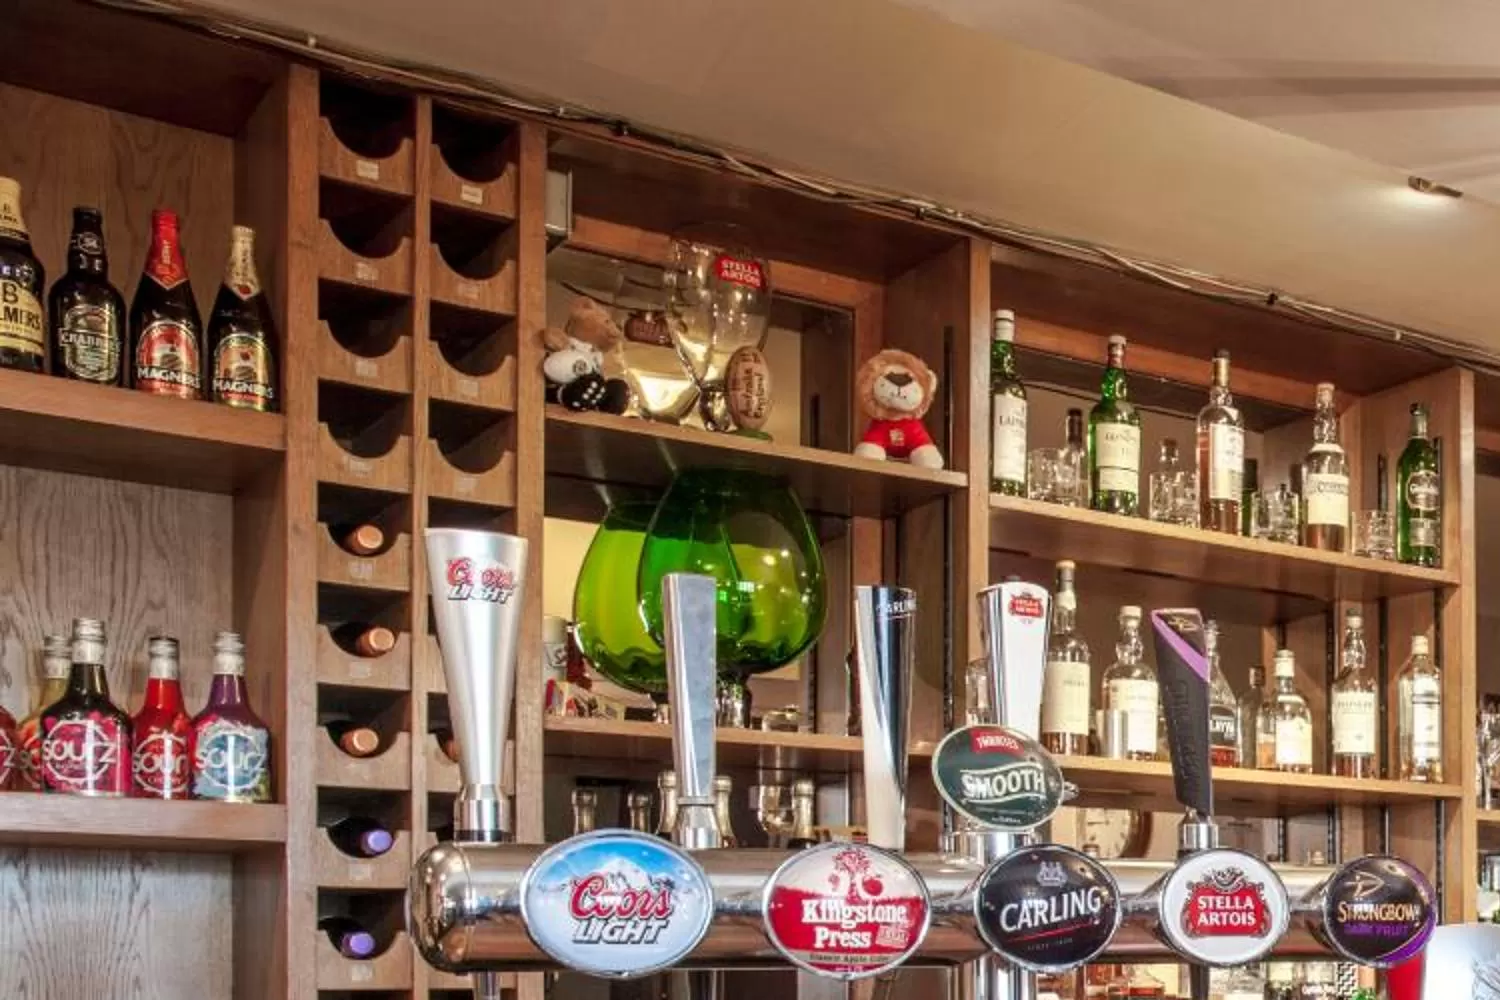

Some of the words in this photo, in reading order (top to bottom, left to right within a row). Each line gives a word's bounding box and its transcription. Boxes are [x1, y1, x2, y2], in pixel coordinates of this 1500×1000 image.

[721, 258, 760, 277] STELLA
[0, 306, 40, 330] MERS
[137, 367, 200, 389] MAGNERS
[212, 379, 274, 399] MAGNERS
[447, 583, 513, 605] LIHT
[41, 739, 118, 764] souz
[132, 752, 190, 774] sour
[961, 769, 1046, 799] SMOOTH
[570, 875, 674, 921] Coors
[1000, 886, 1101, 933] CARLING
[1198, 896, 1255, 910] STELLA
[801, 897, 908, 929] Kingstone
[1198, 912, 1257, 926] ARTOIS
[572, 918, 670, 945] LIGHT
[813, 926, 872, 949] Press
